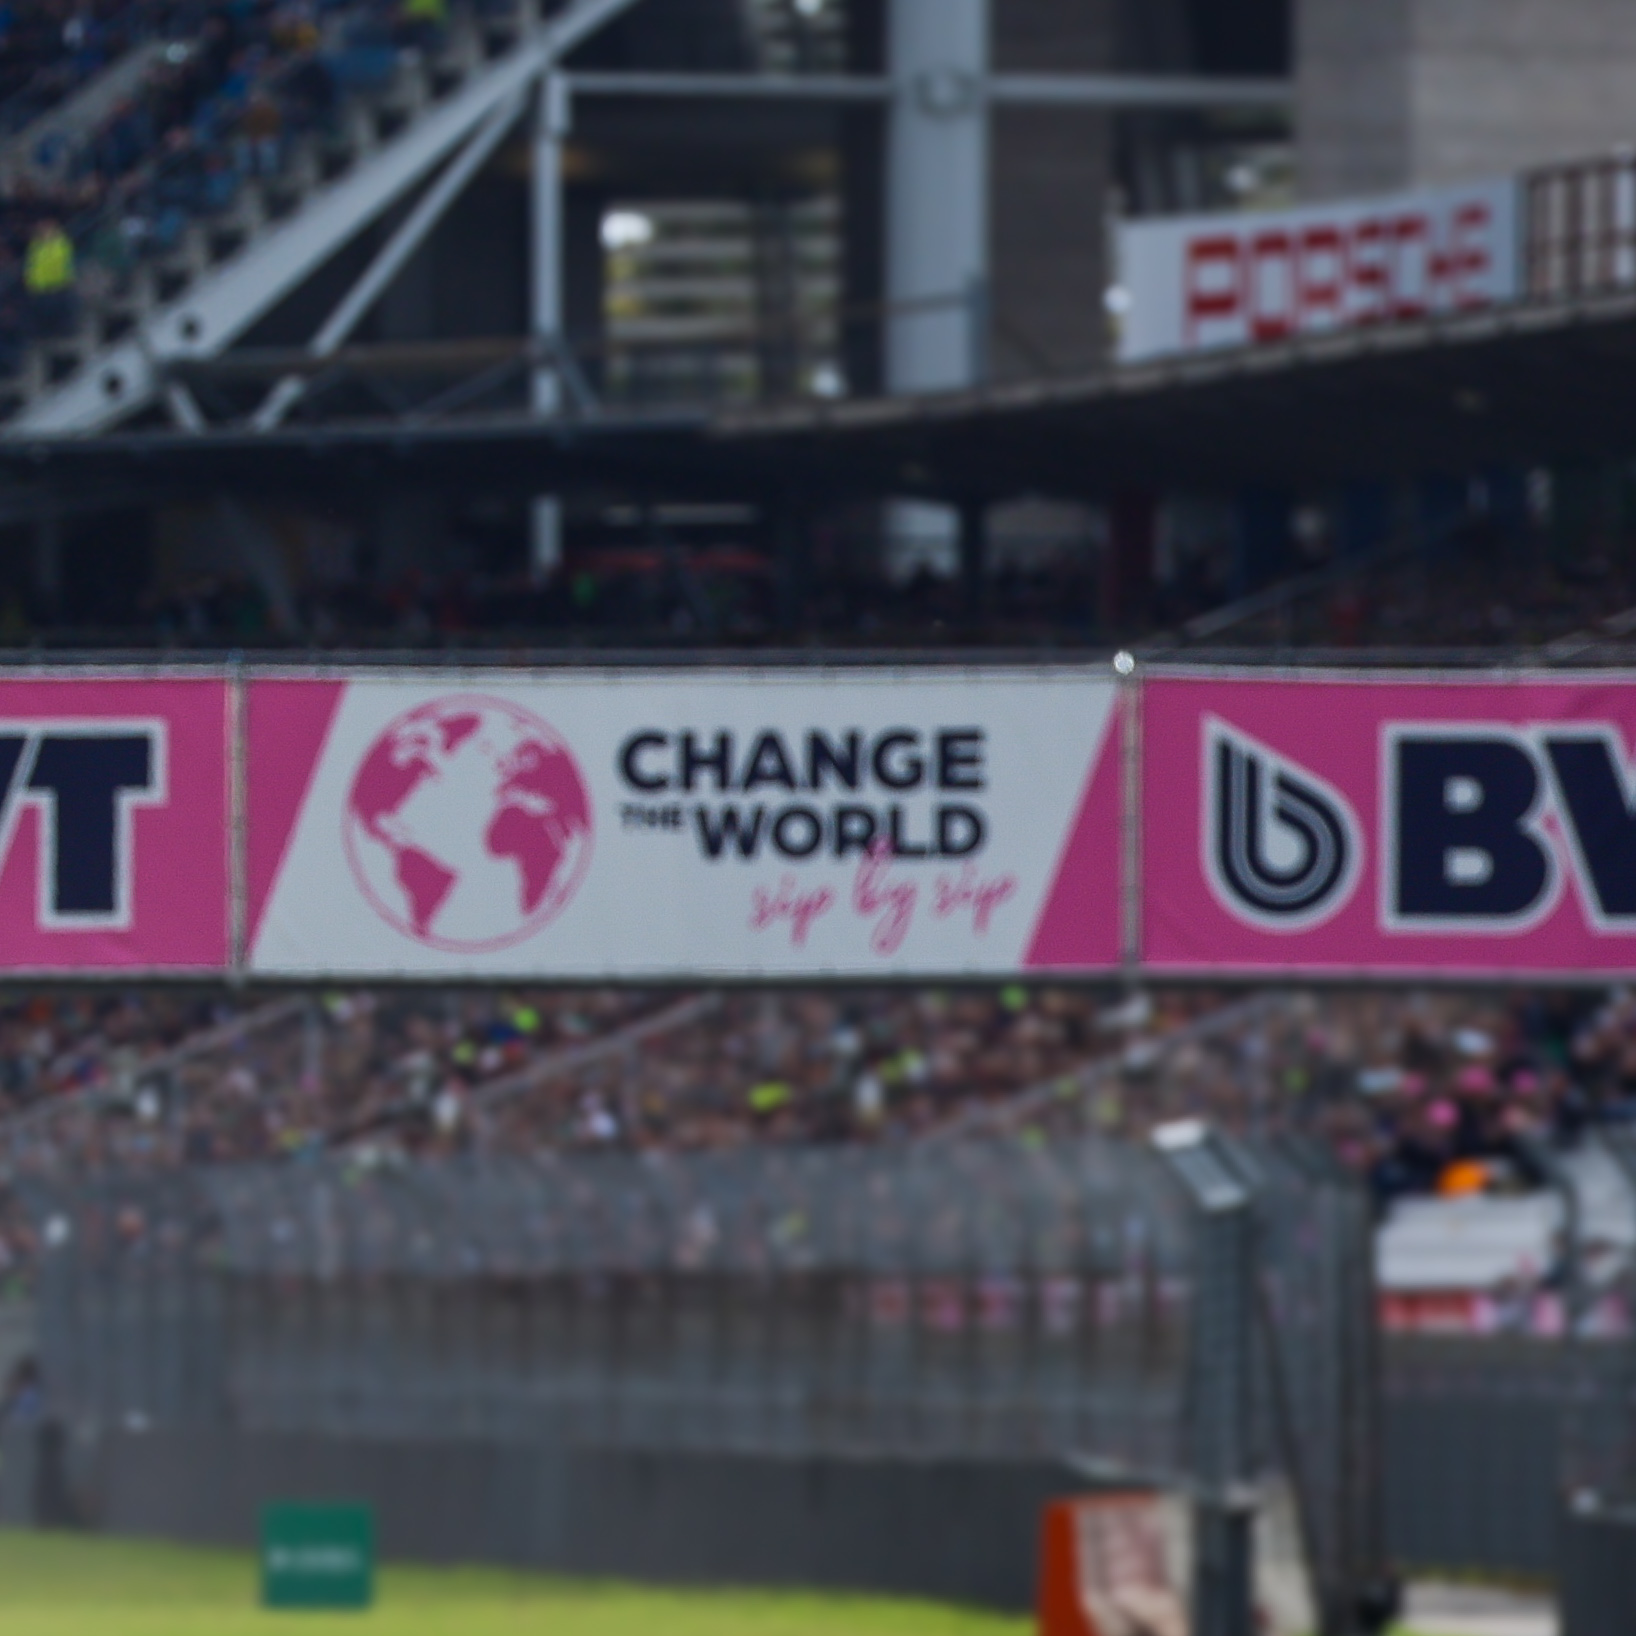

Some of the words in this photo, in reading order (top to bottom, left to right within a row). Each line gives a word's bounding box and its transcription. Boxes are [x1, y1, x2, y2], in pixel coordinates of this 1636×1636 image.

[619, 728, 986, 791] CHANGE
[621, 803, 683, 830] THE
[693, 804, 988, 861] WORLD
